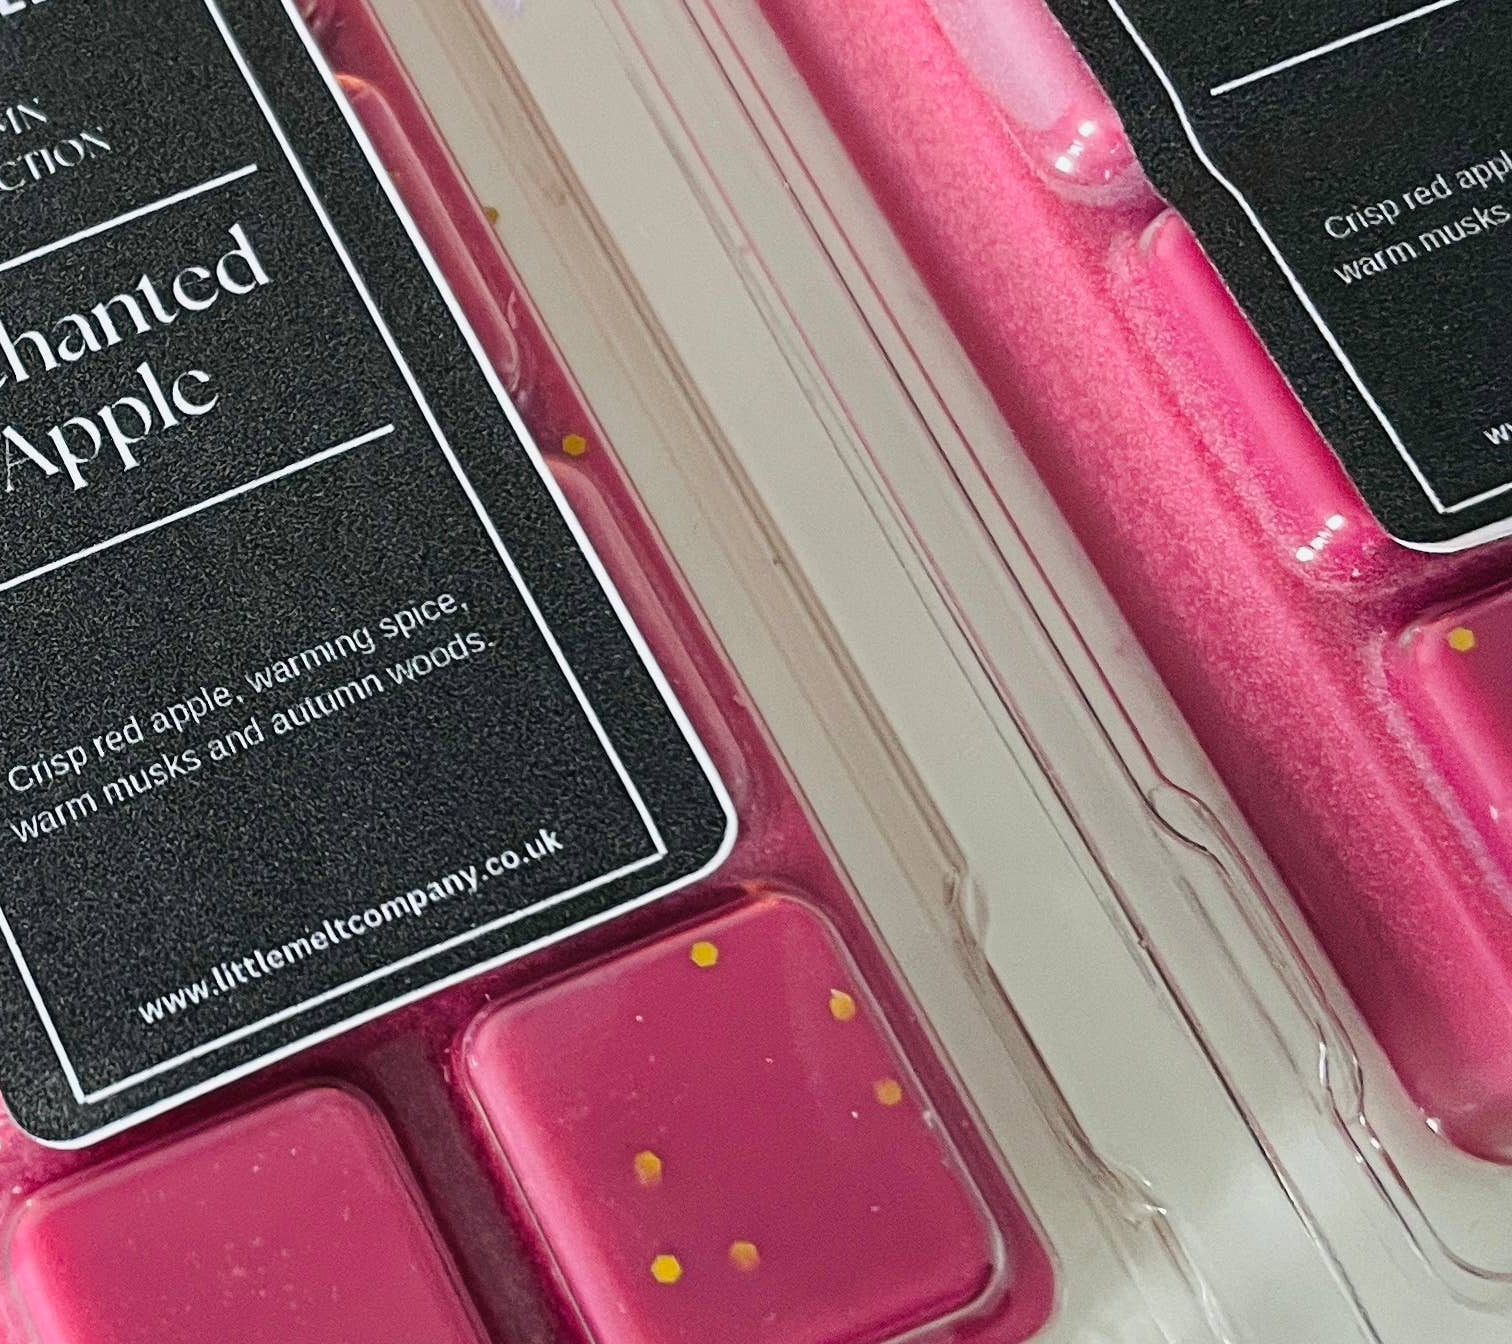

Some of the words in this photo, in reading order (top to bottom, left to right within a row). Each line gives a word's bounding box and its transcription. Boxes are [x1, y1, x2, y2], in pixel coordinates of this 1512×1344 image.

[1324, 199, 1400, 239] Crisp
[1403, 174, 1453, 210] red
[1334, 240, 1418, 285] warm
[1419, 205, 1511, 252] musks
[2, 361, 219, 492] Apple
[8, 743, 87, 792] Crisp
[95, 717, 144, 757] red
[152, 683, 245, 736] apple,
[245, 626, 374, 695] warming
[379, 589, 469, 640] spice,
[11, 792, 97, 843] warm
[103, 749, 201, 806] musks
[208, 717, 264, 762] and
[272, 673, 384, 736] autumn
[386, 628, 495, 684] woods.
[138, 828, 563, 1025] www.littlemeltcompany.co.uk
